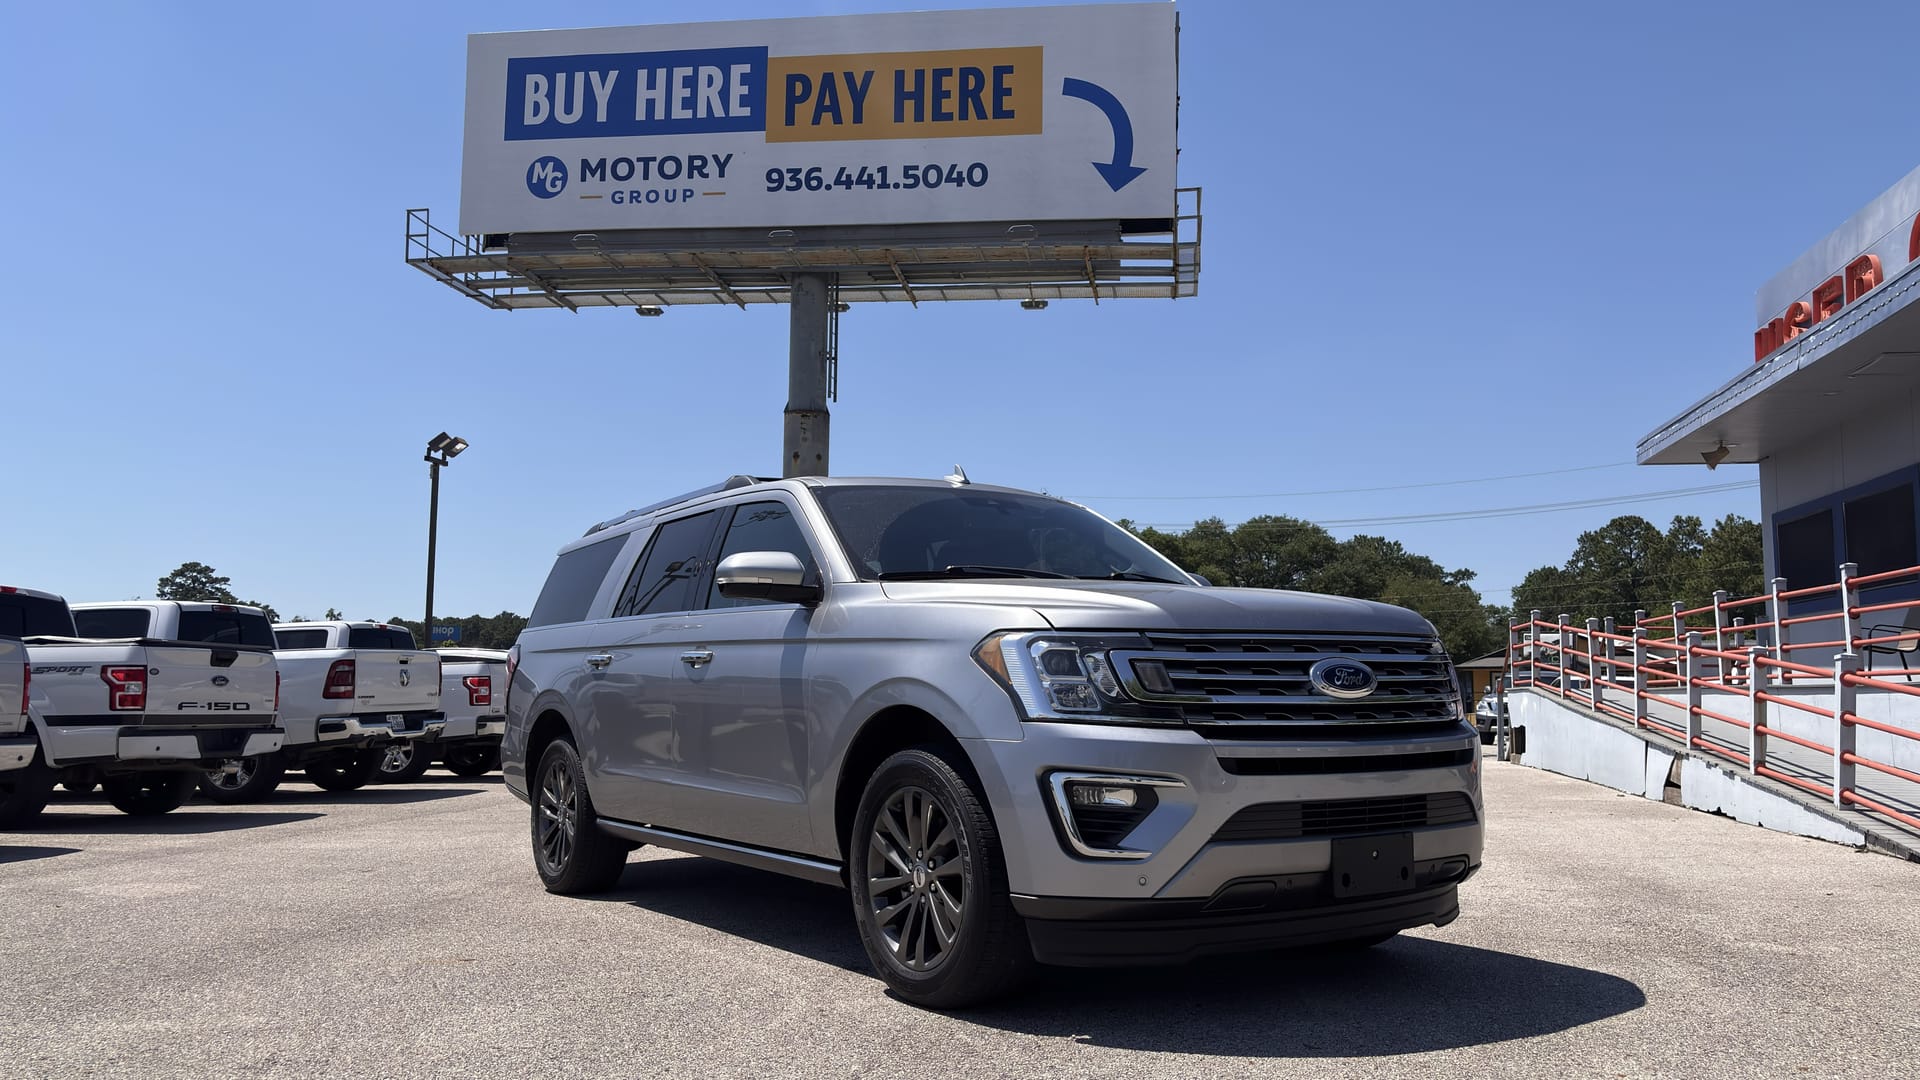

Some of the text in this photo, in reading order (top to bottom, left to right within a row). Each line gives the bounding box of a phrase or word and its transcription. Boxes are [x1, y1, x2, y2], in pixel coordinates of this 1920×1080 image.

[523, 63, 751, 126] BUY HERE
[784, 65, 1015, 126] PAY HERE
[532, 161, 563, 193] MG
[579, 153, 734, 183] MOTORY
[765, 162, 989, 193] 936.441.5040
[610, 188, 695, 205] GROUP
[31, 665, 93, 675] SPORT
[1334, 667, 1364, 686] Ford
[177, 701, 250, 711] F-150
